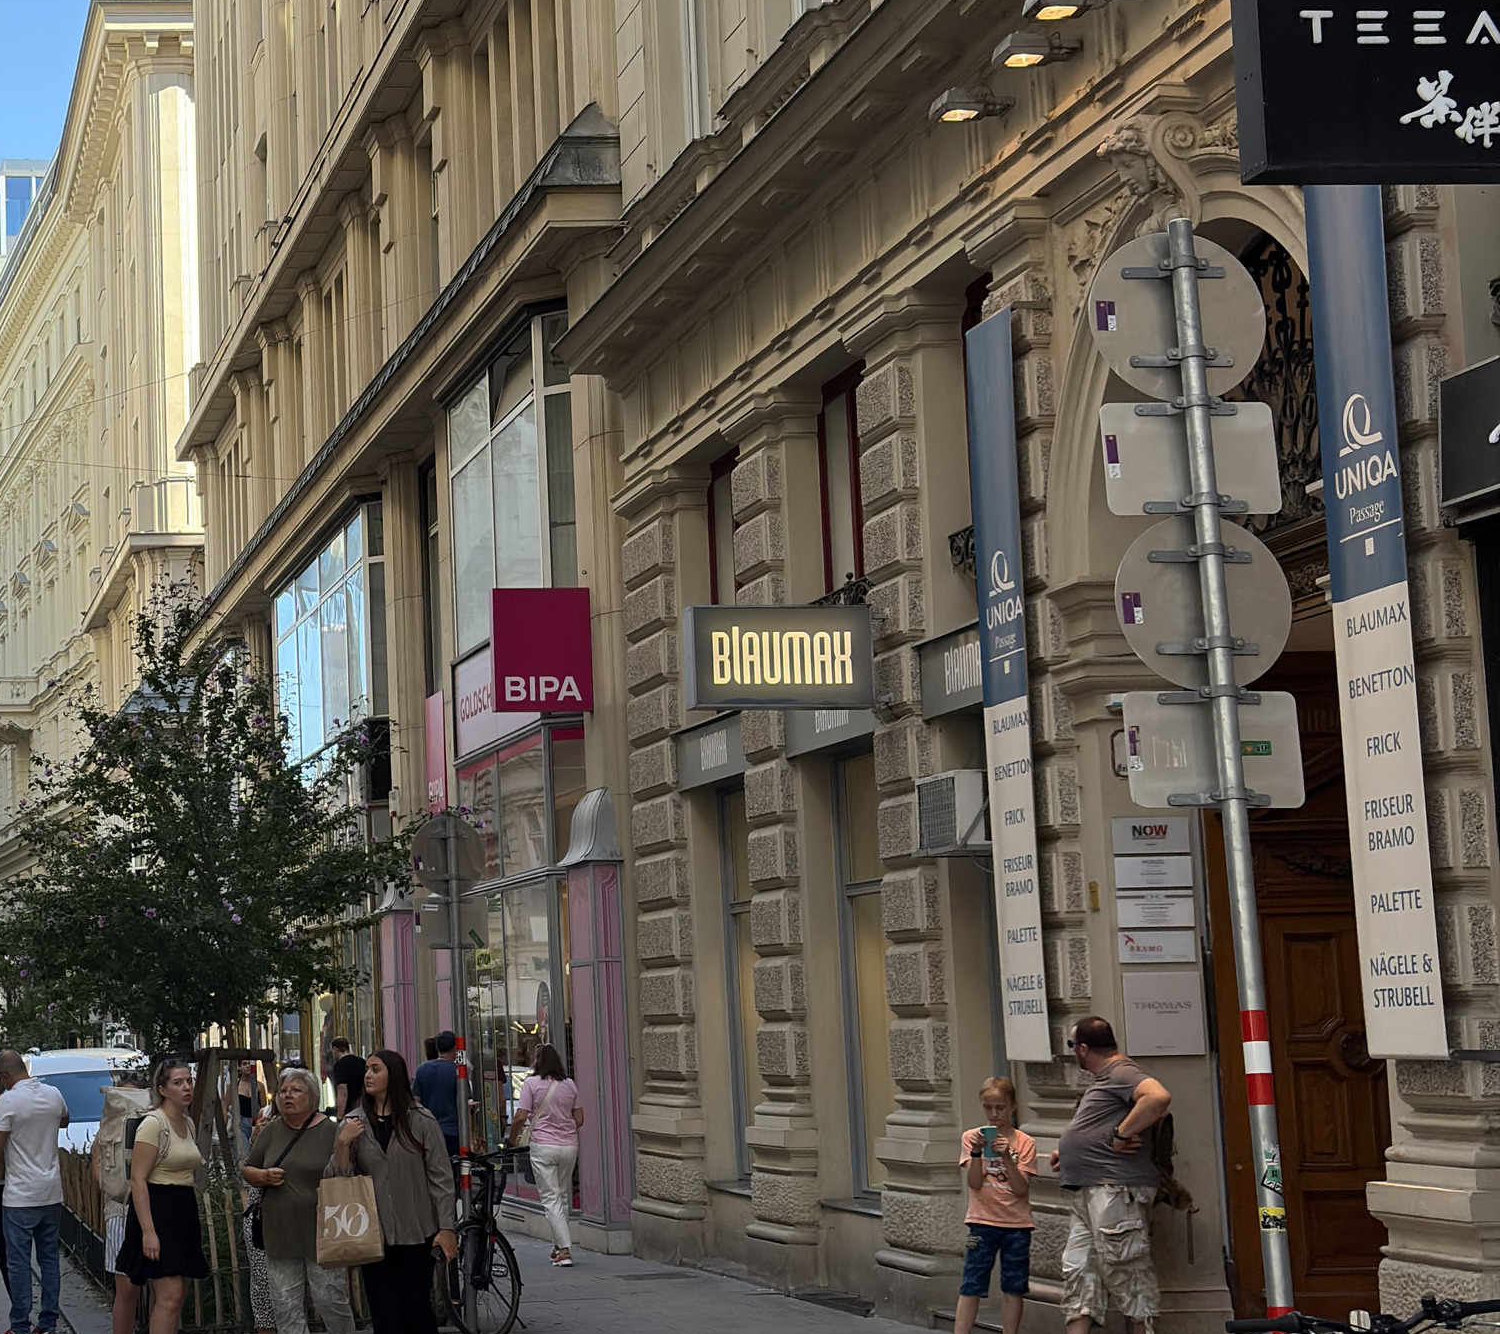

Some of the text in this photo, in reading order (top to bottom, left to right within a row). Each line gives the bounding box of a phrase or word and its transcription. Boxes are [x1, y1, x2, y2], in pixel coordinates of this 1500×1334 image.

[1334, 449, 1398, 500] UNIQA
[1349, 500, 1385, 525] Passage
[985, 595, 1024, 630] UNIQA
[1346, 601, 1408, 638] BLAUMAX
[504, 675, 583, 702] BIPA
[1348, 663, 1415, 700] BENETTON
[459, 681, 493, 723] GOLDSCH
[1366, 731, 1402, 758] FRICK
[1004, 807, 1026, 826] FRICK
[1364, 793, 1415, 821] FRISEUR
[1131, 824, 1168, 837] NOW
[1368, 825, 1415, 852] BRAMO
[1003, 854, 1034, 874] FRISEUR
[1005, 878, 1034, 898] BRAMO
[1370, 889, 1423, 914] PALETTE
[1007, 926, 1038, 944] PALETTE
[1369, 952, 1433, 977] NÄGELE &
[1008, 999, 1044, 1016] STRUBELL
[1133, 1001, 1192, 1010] THOMAS
[1373, 985, 1435, 1009] STRUBELL
